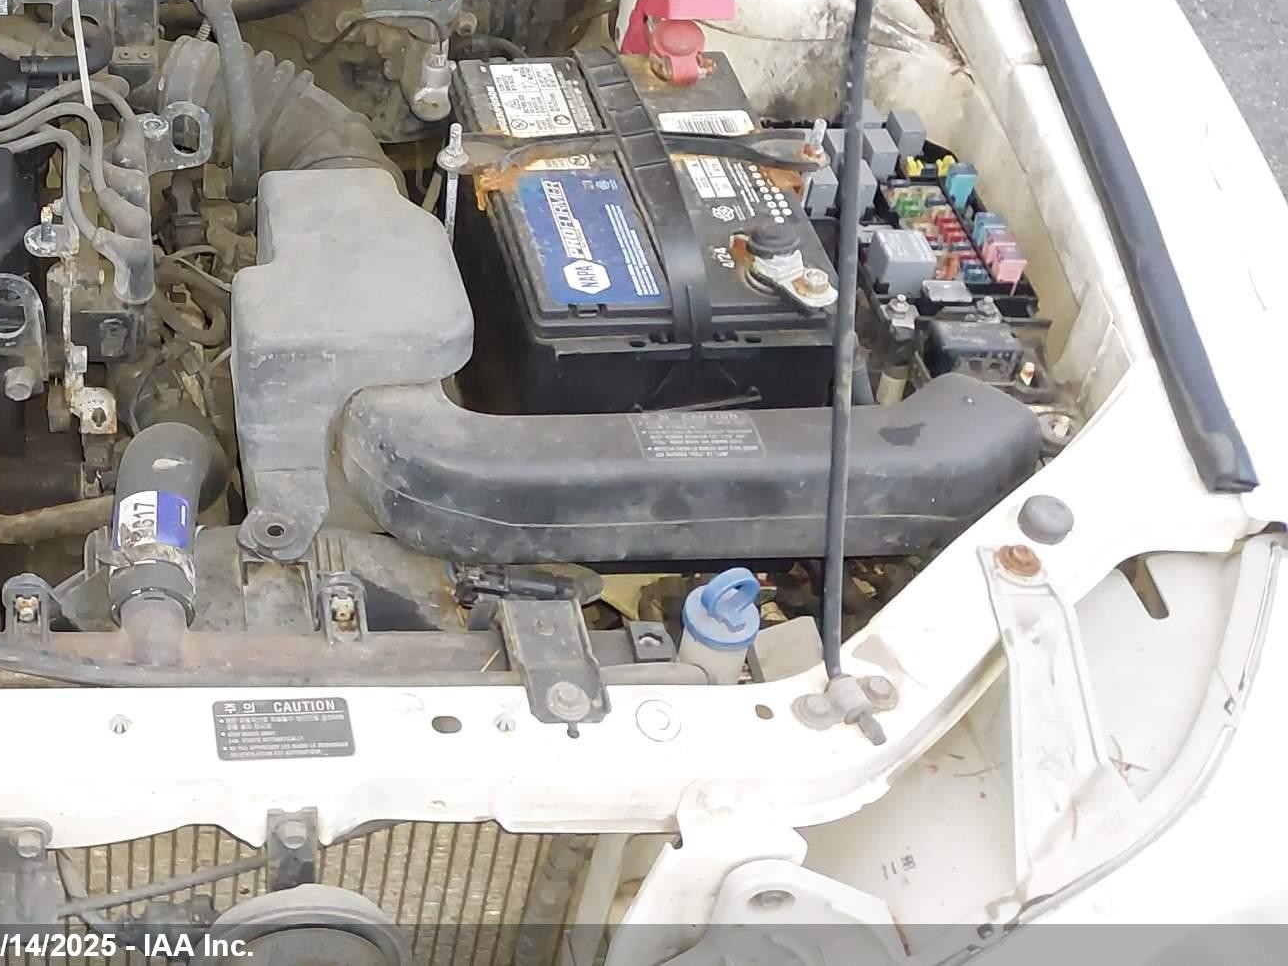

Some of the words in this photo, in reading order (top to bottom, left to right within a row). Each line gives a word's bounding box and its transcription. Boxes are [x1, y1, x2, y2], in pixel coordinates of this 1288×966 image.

[543, 179, 585, 258] PROFORMER
[714, 247, 735, 268] 4/24
[575, 266, 600, 287] NAPA
[273, 700, 335, 713] CAUTION
